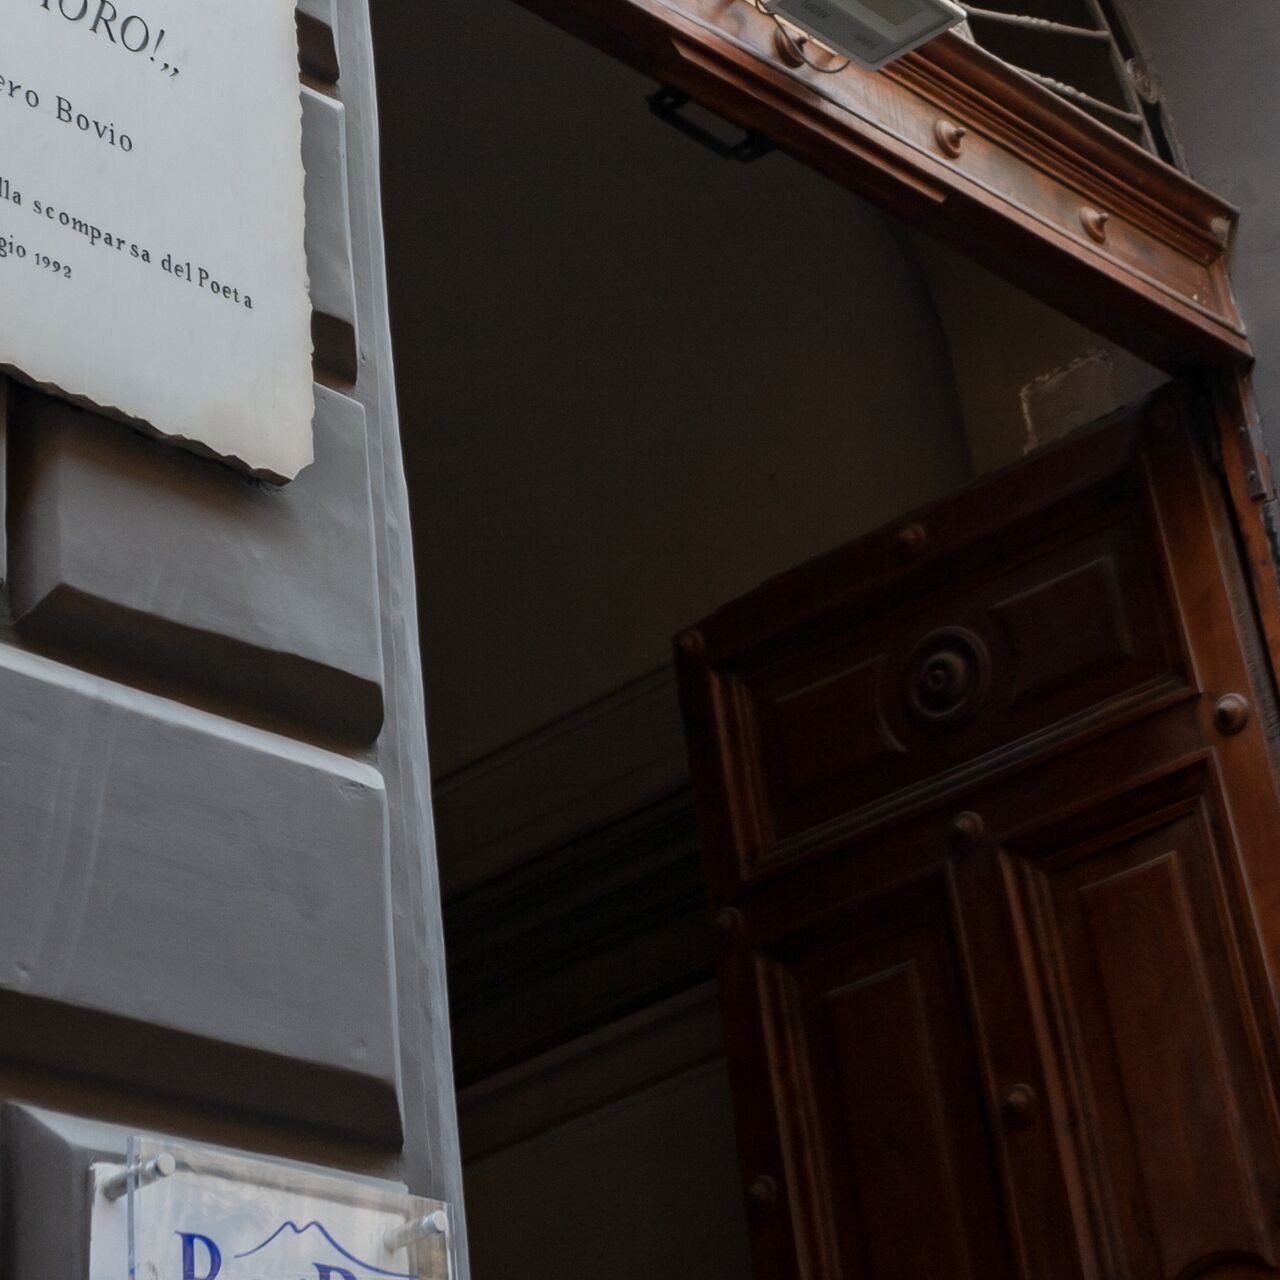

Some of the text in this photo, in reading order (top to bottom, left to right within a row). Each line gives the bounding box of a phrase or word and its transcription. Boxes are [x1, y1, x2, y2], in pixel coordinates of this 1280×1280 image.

[55, 95, 134, 153] Bovio
[32, 199, 152, 264] scomparsa
[34, 252, 73, 280] 1992
